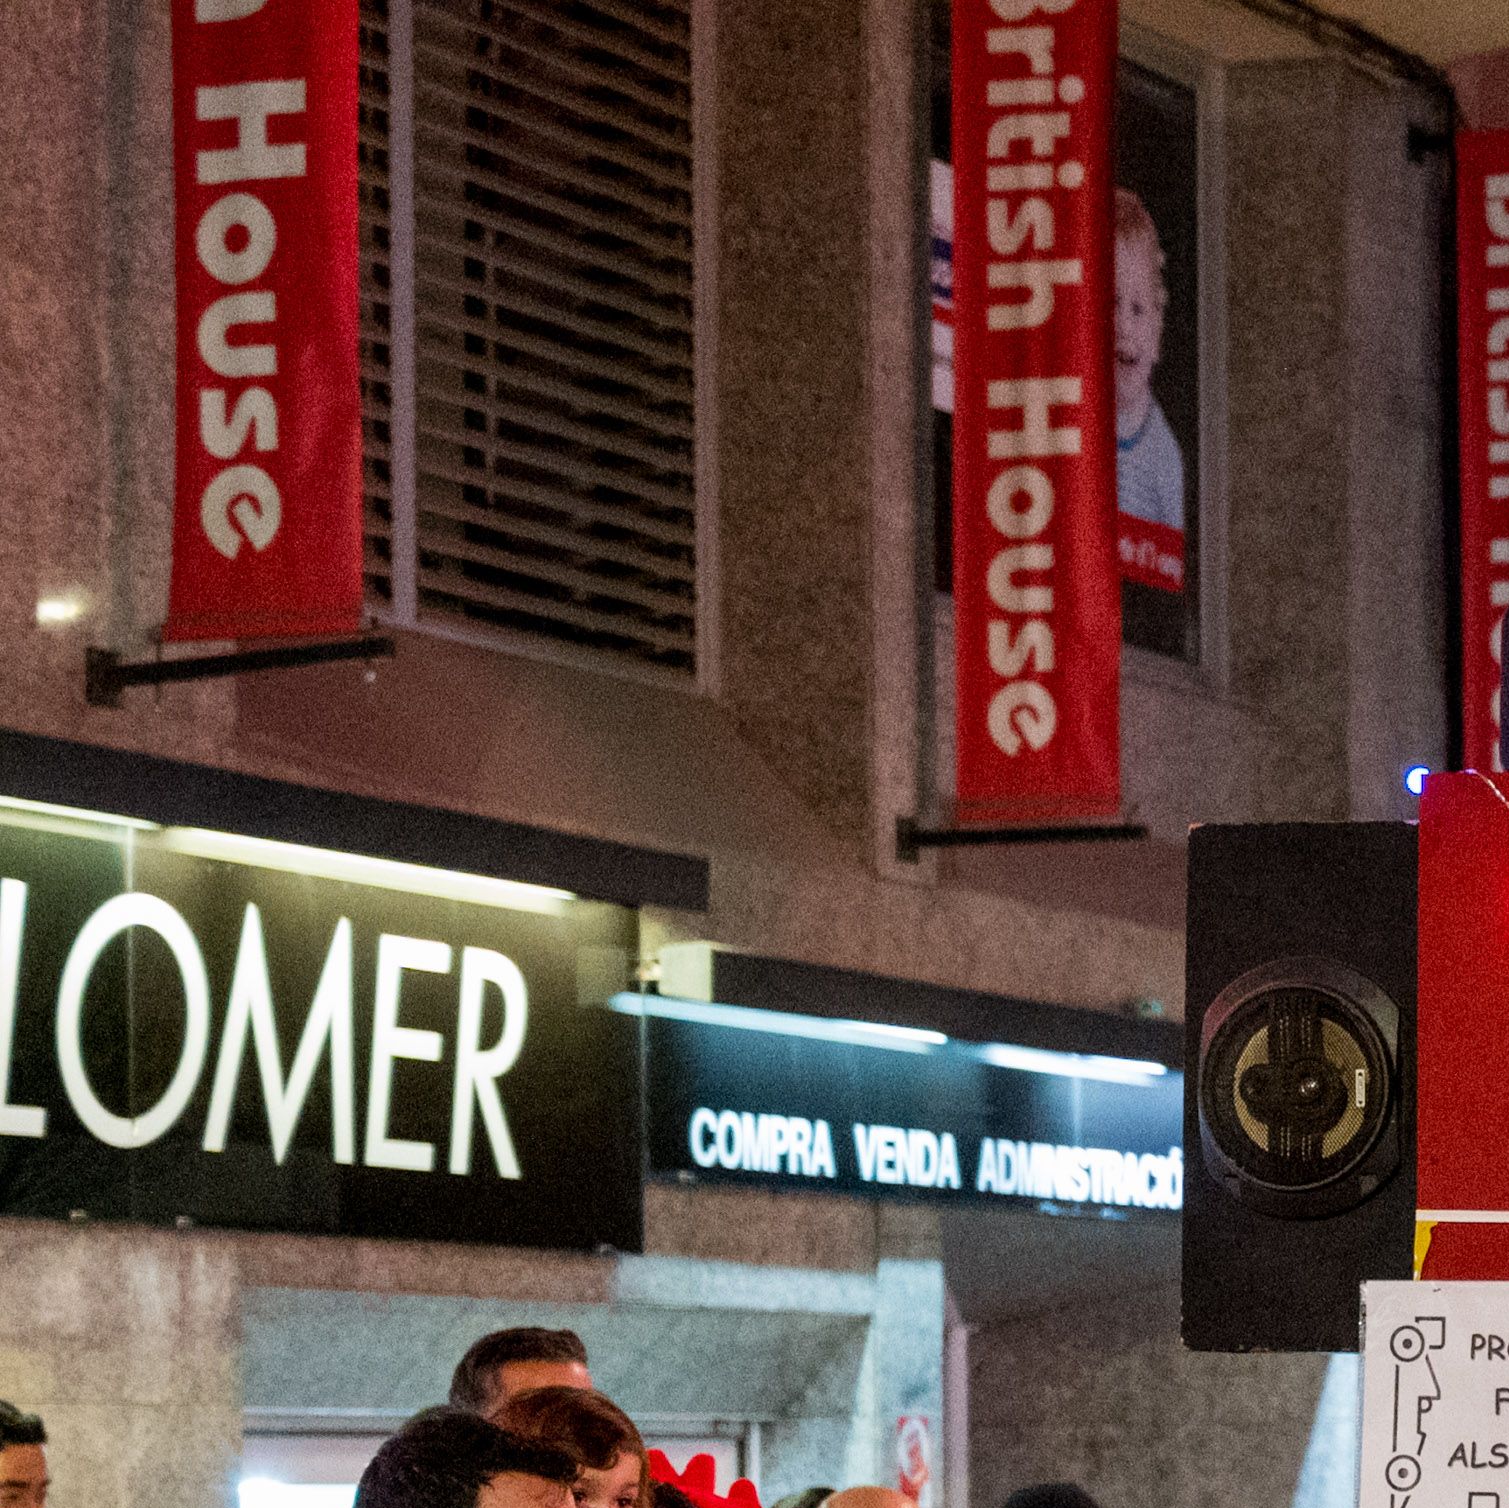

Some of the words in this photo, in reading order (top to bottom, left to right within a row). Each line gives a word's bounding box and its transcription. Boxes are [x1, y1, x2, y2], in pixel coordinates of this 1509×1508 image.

[196, 78, 307, 560] House
[987, 0, 1085, 331] ritish
[987, 376, 1082, 756] House
[689, 1107, 836, 1178] COMPRA
[852, 1122, 962, 1189] VENDA
